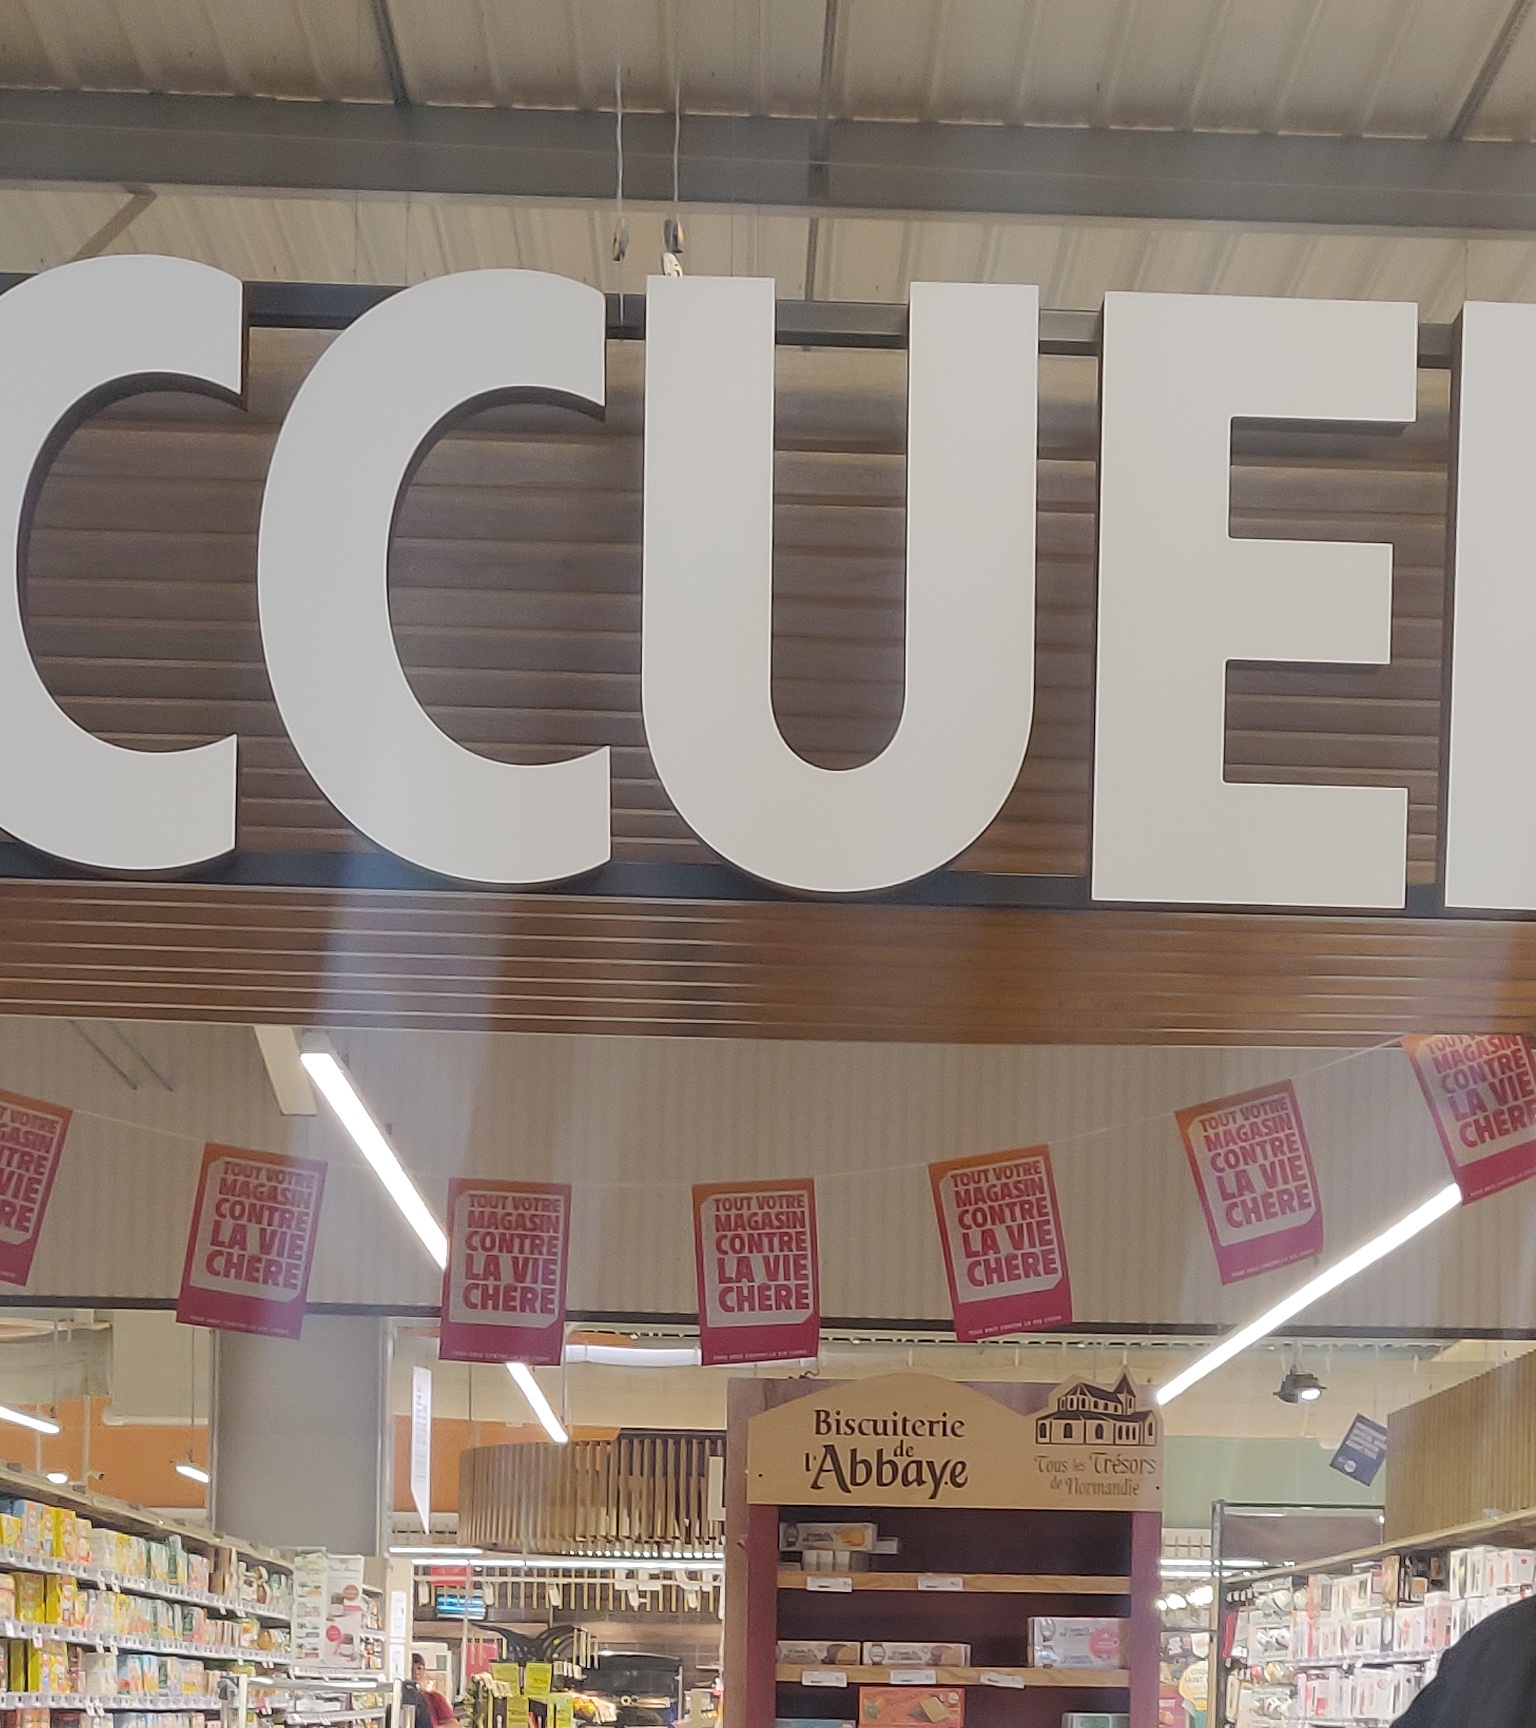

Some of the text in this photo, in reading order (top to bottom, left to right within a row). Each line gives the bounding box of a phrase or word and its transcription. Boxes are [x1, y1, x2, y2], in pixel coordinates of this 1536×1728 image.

[1198, 1110, 1241, 1134] TOUT
[1204, 1112, 1295, 1154] MAGASIN
[1209, 1133, 1301, 1177] CONTRE
[222, 1160, 265, 1179] TOUT
[1215, 1157, 1306, 1204] LA VIE
[220, 1176, 314, 1208] MAGASIN
[713, 1197, 754, 1212] TOUT
[215, 1197, 311, 1232] CONTRE
[715, 1211, 805, 1232] MAGASIN
[211, 1221, 307, 1260] LA VIE
[716, 1231, 807, 1255] CONTRE
[718, 1255, 808, 1284] LA VIE
[814, 1409, 965, 1438] Biscuiterie
[893, 1440, 914, 1459] de
[1034, 1456, 1068, 1473] Tous
[1089, 1452, 1156, 1475] Trésors
[1064, 1477, 1140, 1496] Normandie
